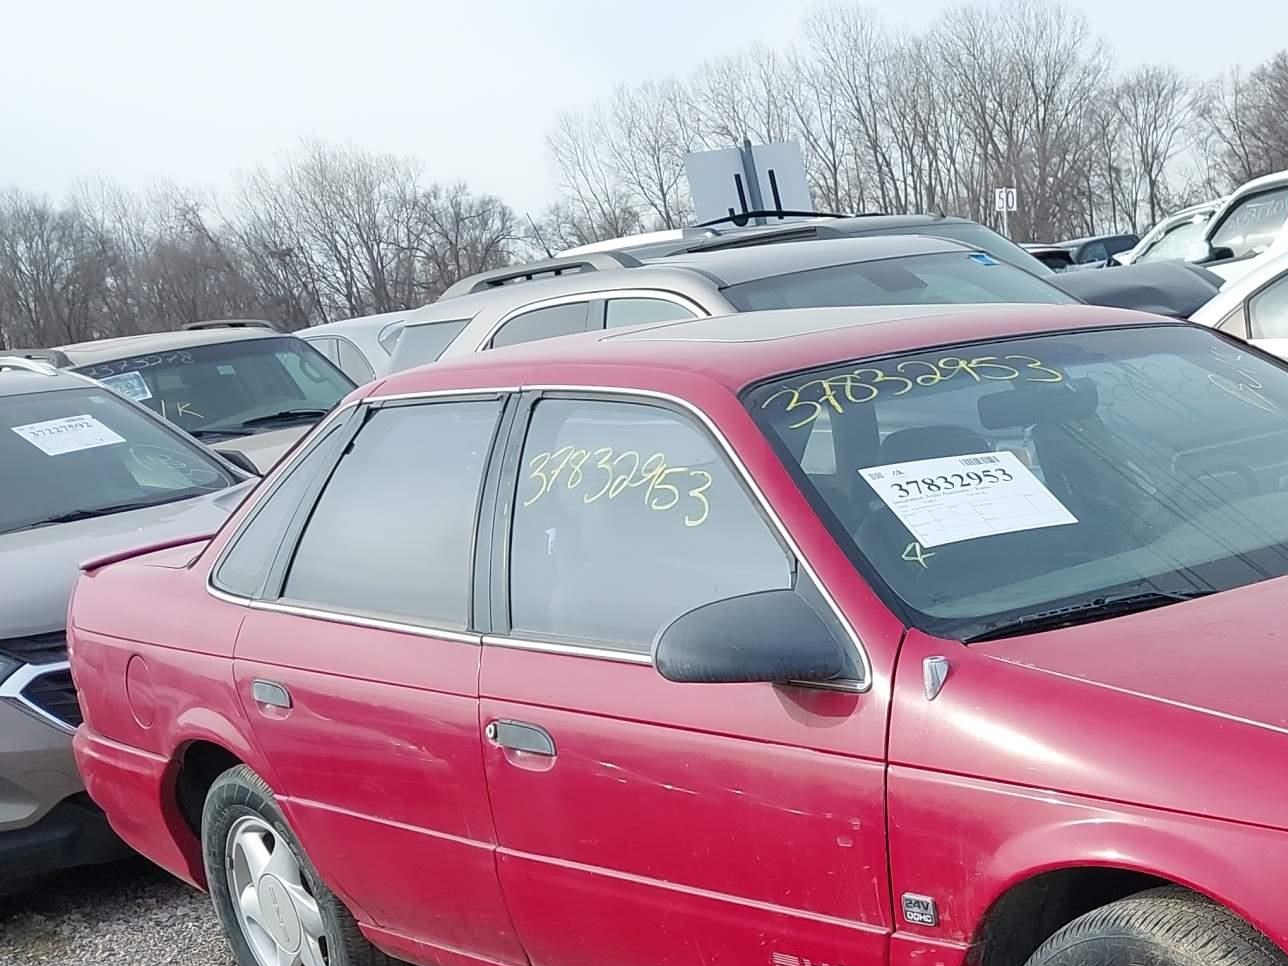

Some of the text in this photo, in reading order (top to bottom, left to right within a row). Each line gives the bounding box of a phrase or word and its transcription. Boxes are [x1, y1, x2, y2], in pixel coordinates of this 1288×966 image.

[998, 190, 1015, 210] 50
[762, 355, 1063, 429] 37832953
[524, 446, 712, 527] 37832953
[890, 468, 1014, 498] 37832953
[905, 898, 930, 911] 24V
[906, 911, 933, 923] DOHC
